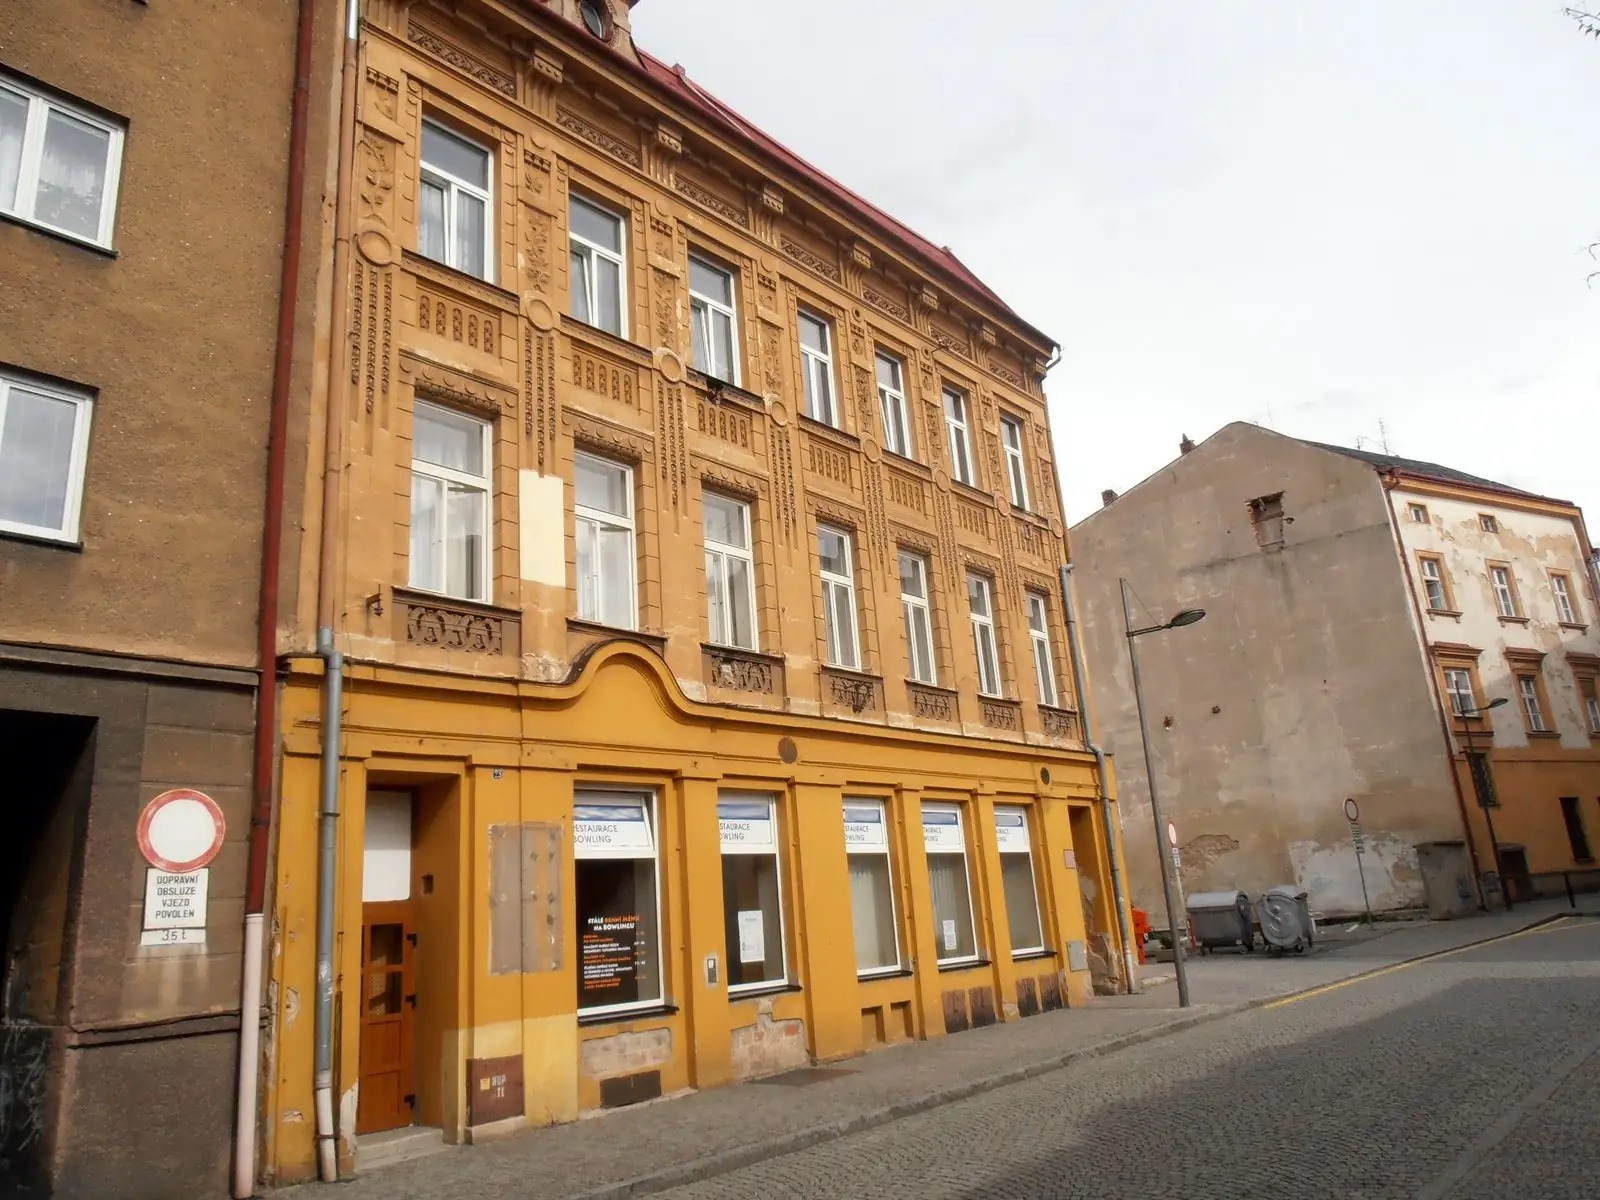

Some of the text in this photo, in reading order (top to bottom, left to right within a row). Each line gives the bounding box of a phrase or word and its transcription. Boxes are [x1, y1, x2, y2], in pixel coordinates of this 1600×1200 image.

[573, 824, 618, 832] ESTAURACE
[157, 875, 198, 884] DOPRAVNÍ
[162, 899, 190, 907] VJEZD
[155, 910, 195, 919] POVOLEN
